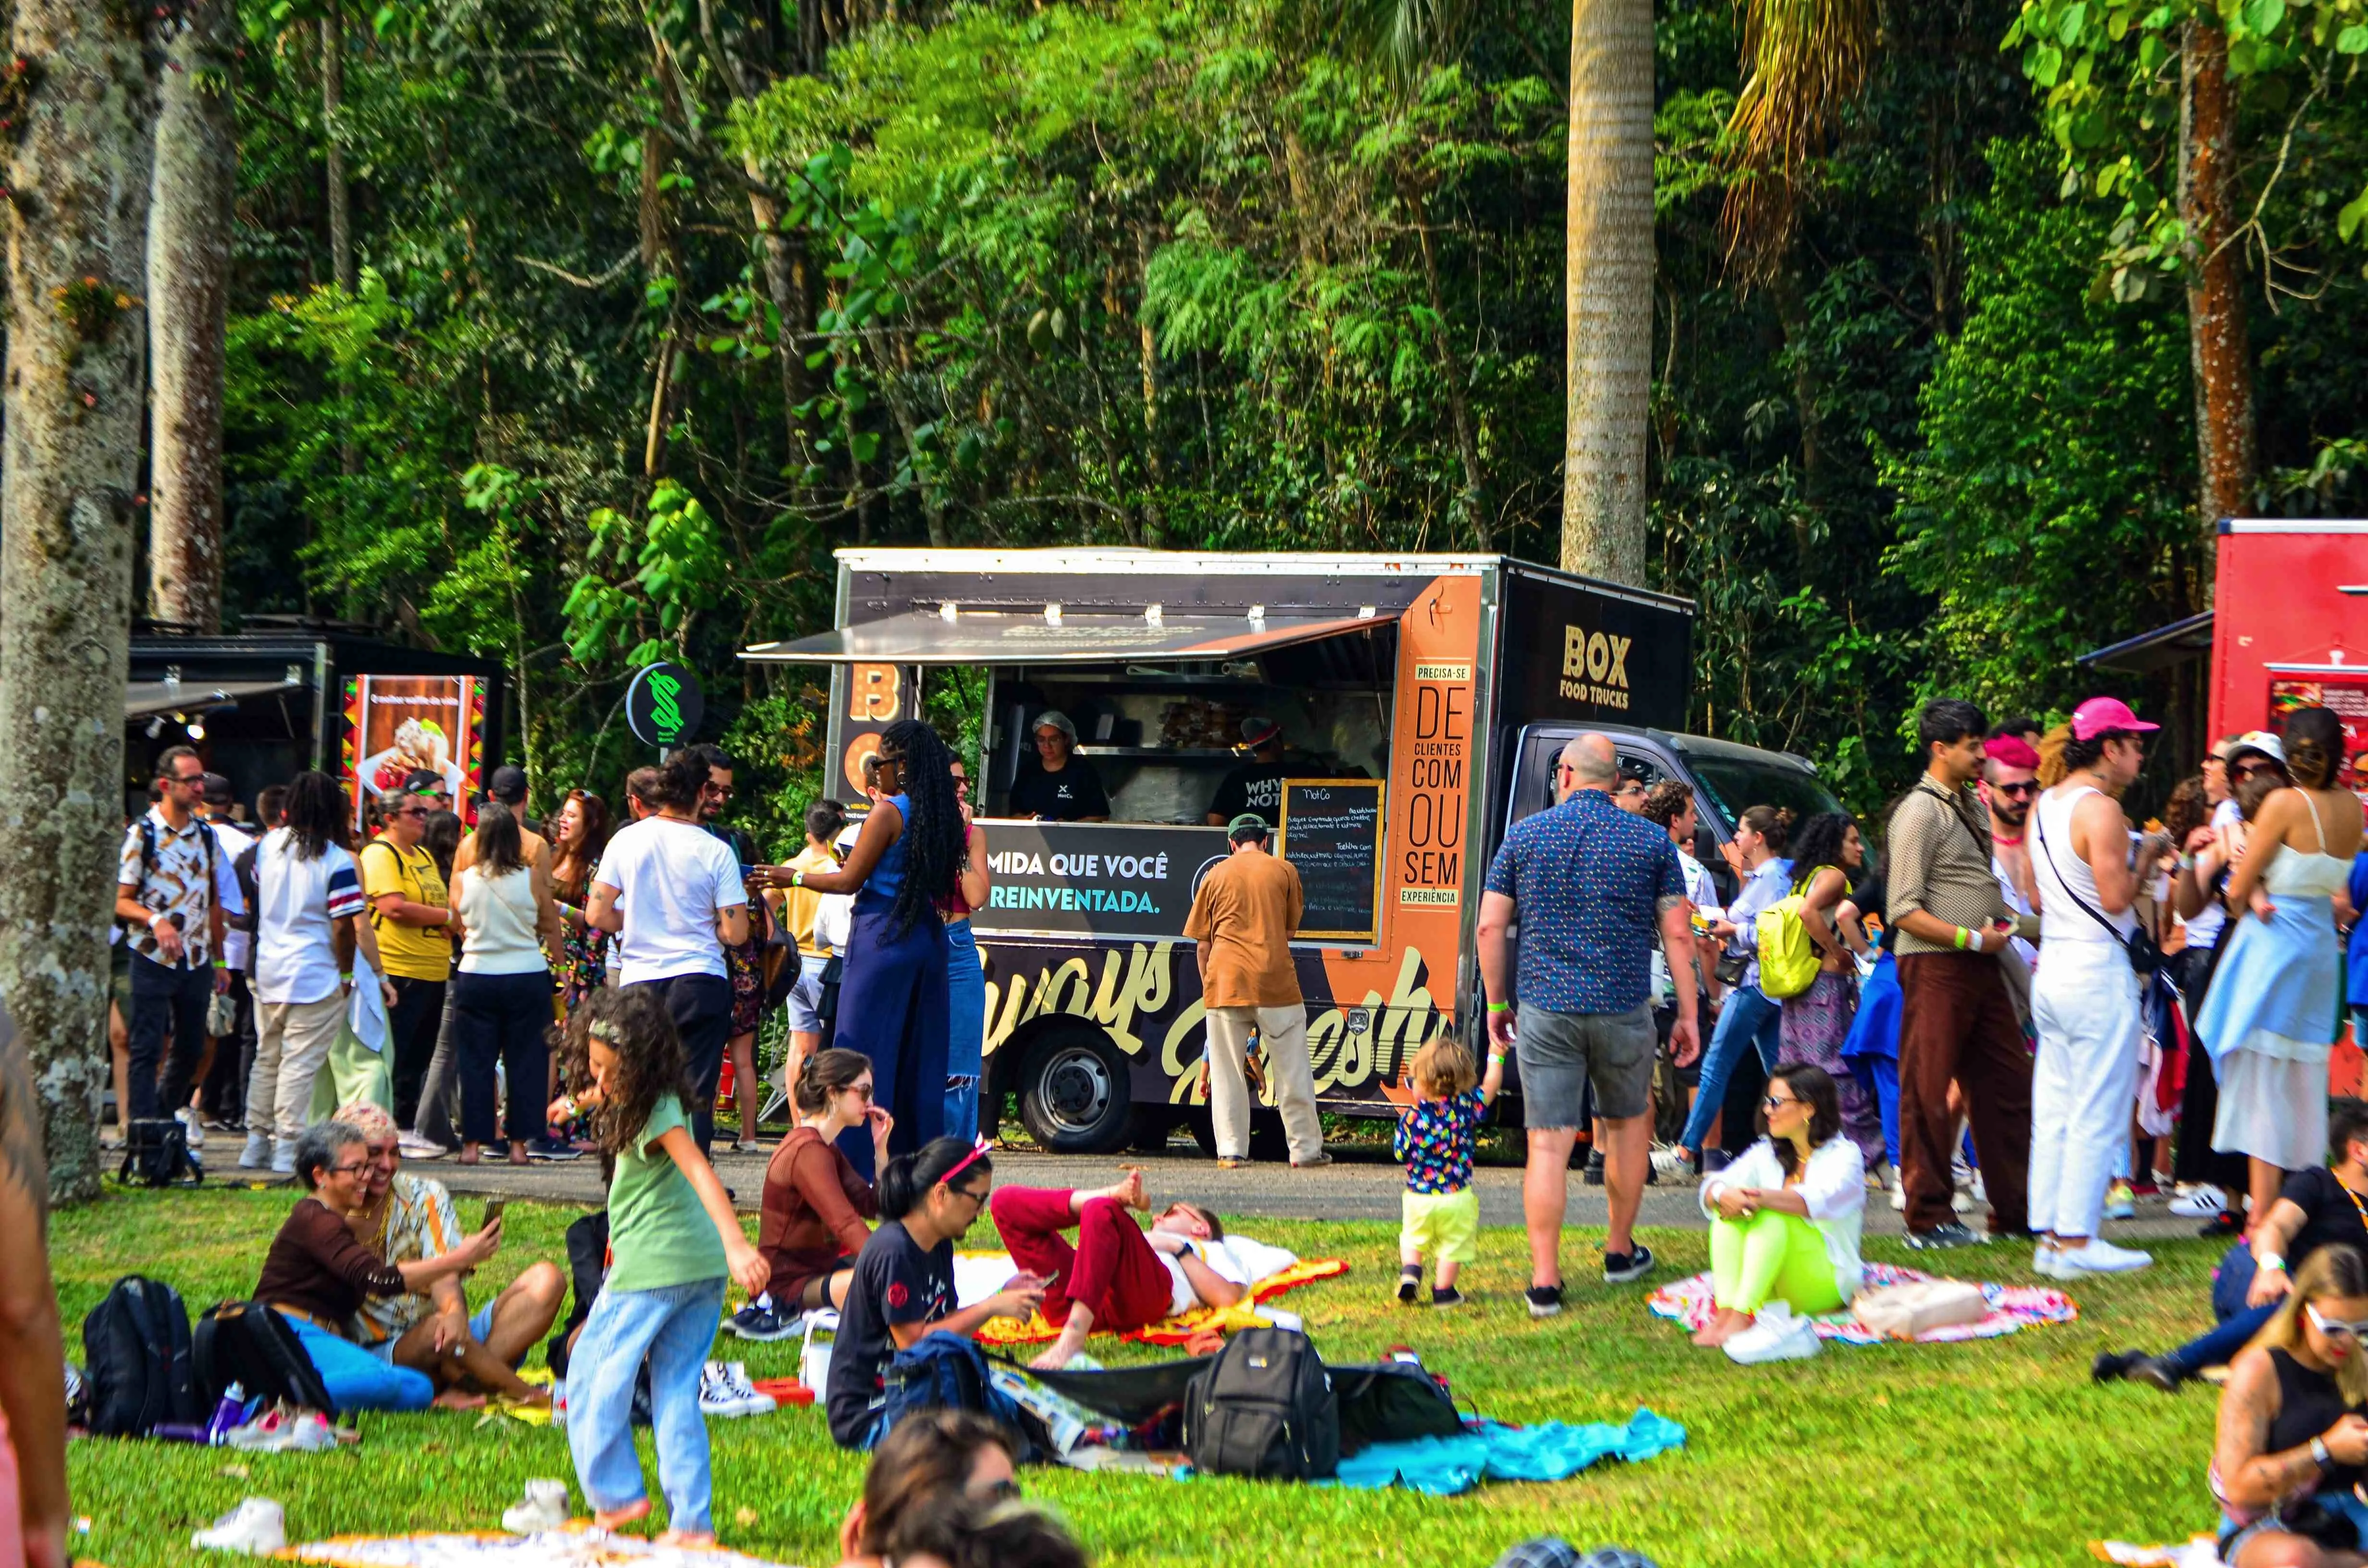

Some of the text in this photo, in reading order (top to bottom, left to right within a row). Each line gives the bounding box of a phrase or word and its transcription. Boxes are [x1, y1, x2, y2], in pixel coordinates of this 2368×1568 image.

[1563, 625, 1631, 689] BOX
[1418, 667, 1466, 679] PRECISA-SE
[1560, 680, 1629, 710] FOOD TRUCKS
[1416, 686, 1467, 740] DE
[1414, 743, 1461, 756] CLIENTES
[1246, 779, 1282, 795] WHY
[1412, 759, 1461, 788] COM
[1246, 793, 1281, 807] NOT
[1408, 793, 1461, 848] OU
[987, 851, 1168, 879] MIDA QUE VOCÊ
[1405, 851, 1457, 885] SEM
[990, 886, 1160, 914] REINVENTADA.
[1402, 886, 1455, 903] EXPERIÊNCIA
[981, 941, 1172, 1056] ways
